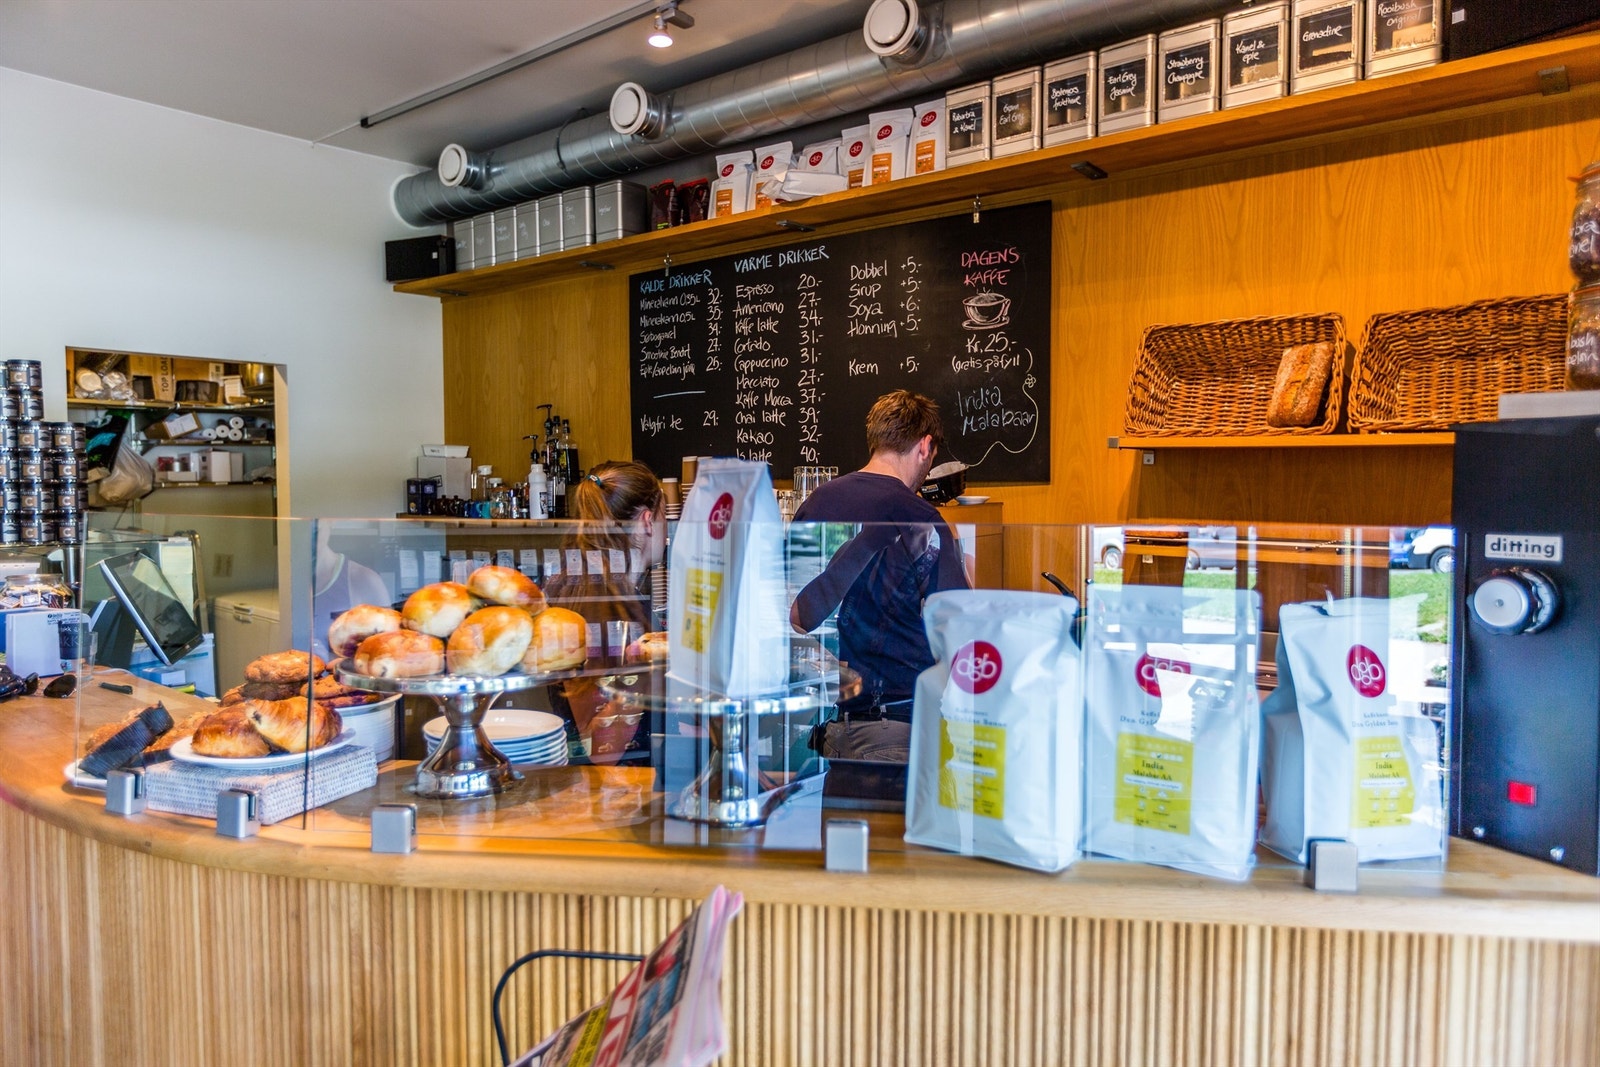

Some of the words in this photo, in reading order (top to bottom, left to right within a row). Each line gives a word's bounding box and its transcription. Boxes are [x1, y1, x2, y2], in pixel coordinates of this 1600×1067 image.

[1303, 24, 1342, 42] Grenadine
[1167, 56, 1204, 70] Strawberry
[1242, 52, 1260, 64] eple
[734, 254, 773, 273] VARME
[778, 245, 830, 268] DRIKKER
[961, 246, 1020, 268] DAGENS
[850, 260, 888, 281] Dobbel
[964, 268, 1011, 288] KAFFE
[640, 279, 665, 294] KALDE
[669, 269, 712, 289] DRIKKER
[848, 283, 882, 298] Sirup
[736, 284, 774, 301] Espresso
[732, 298, 784, 318] Americano
[848, 298, 884, 321] Soya
[734, 318, 754, 336] Kaffe
[757, 318, 780, 334] latte
[848, 318, 898, 338] Honning
[734, 336, 771, 355] Cortado
[734, 353, 789, 374] Cappuccino
[849, 358, 879, 376] Krem
[736, 374, 780, 390] Macciato
[736, 392, 759, 410] Kaffe
[764, 390, 793, 407] Mocca
[670, 414, 684, 431] te
[735, 411, 756, 426] Chai
[762, 409, 787, 426] latte
[736, 430, 774, 445] Kakao
[1490, 538, 1555, 558] ditting
[1142, 760, 1164, 770] India
[1376, 762, 1393, 770] India
